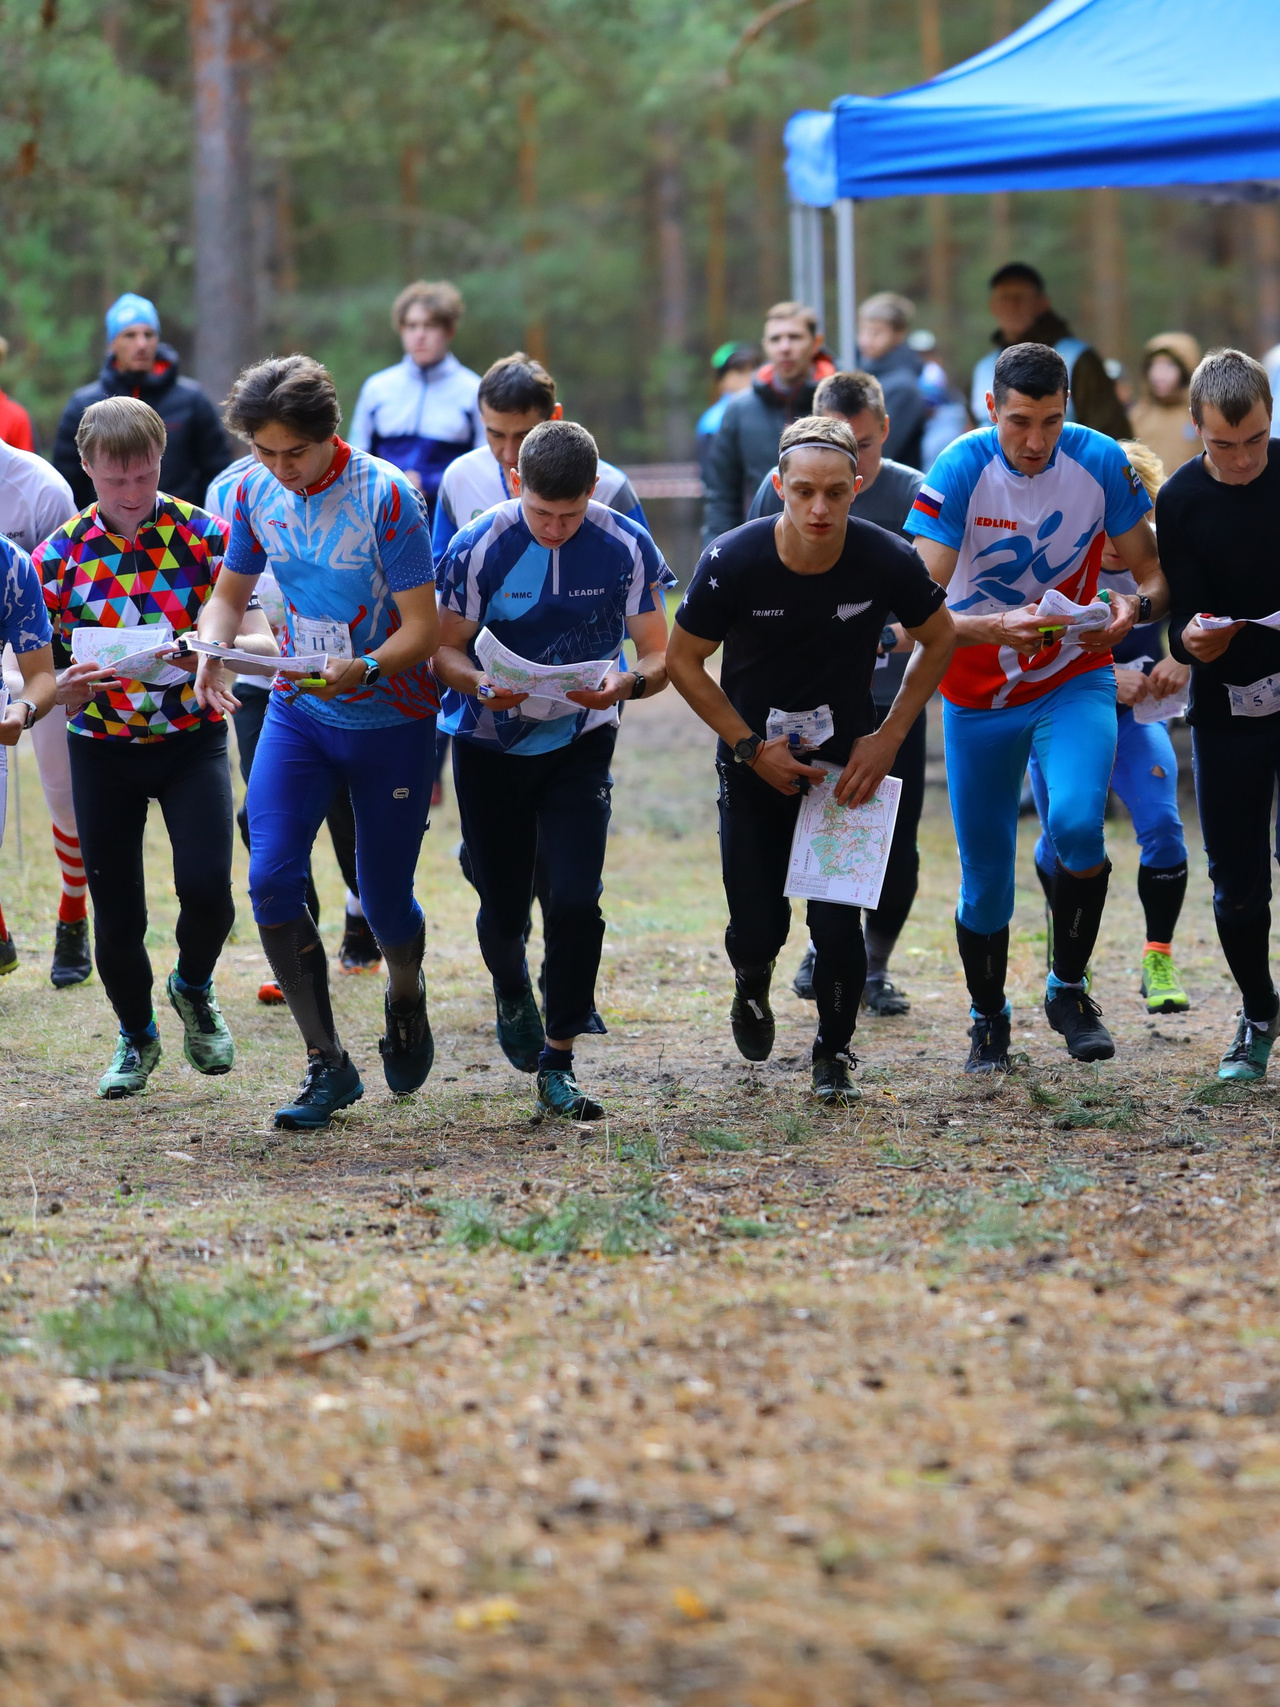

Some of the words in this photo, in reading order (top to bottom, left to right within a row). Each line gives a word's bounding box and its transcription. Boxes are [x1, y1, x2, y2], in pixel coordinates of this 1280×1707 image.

[568, 588, 606, 597] LEADER
[752, 609, 785, 617] TRIMTEX
[312, 636, 326, 651] 11
[1253, 695, 1263, 707] 5
